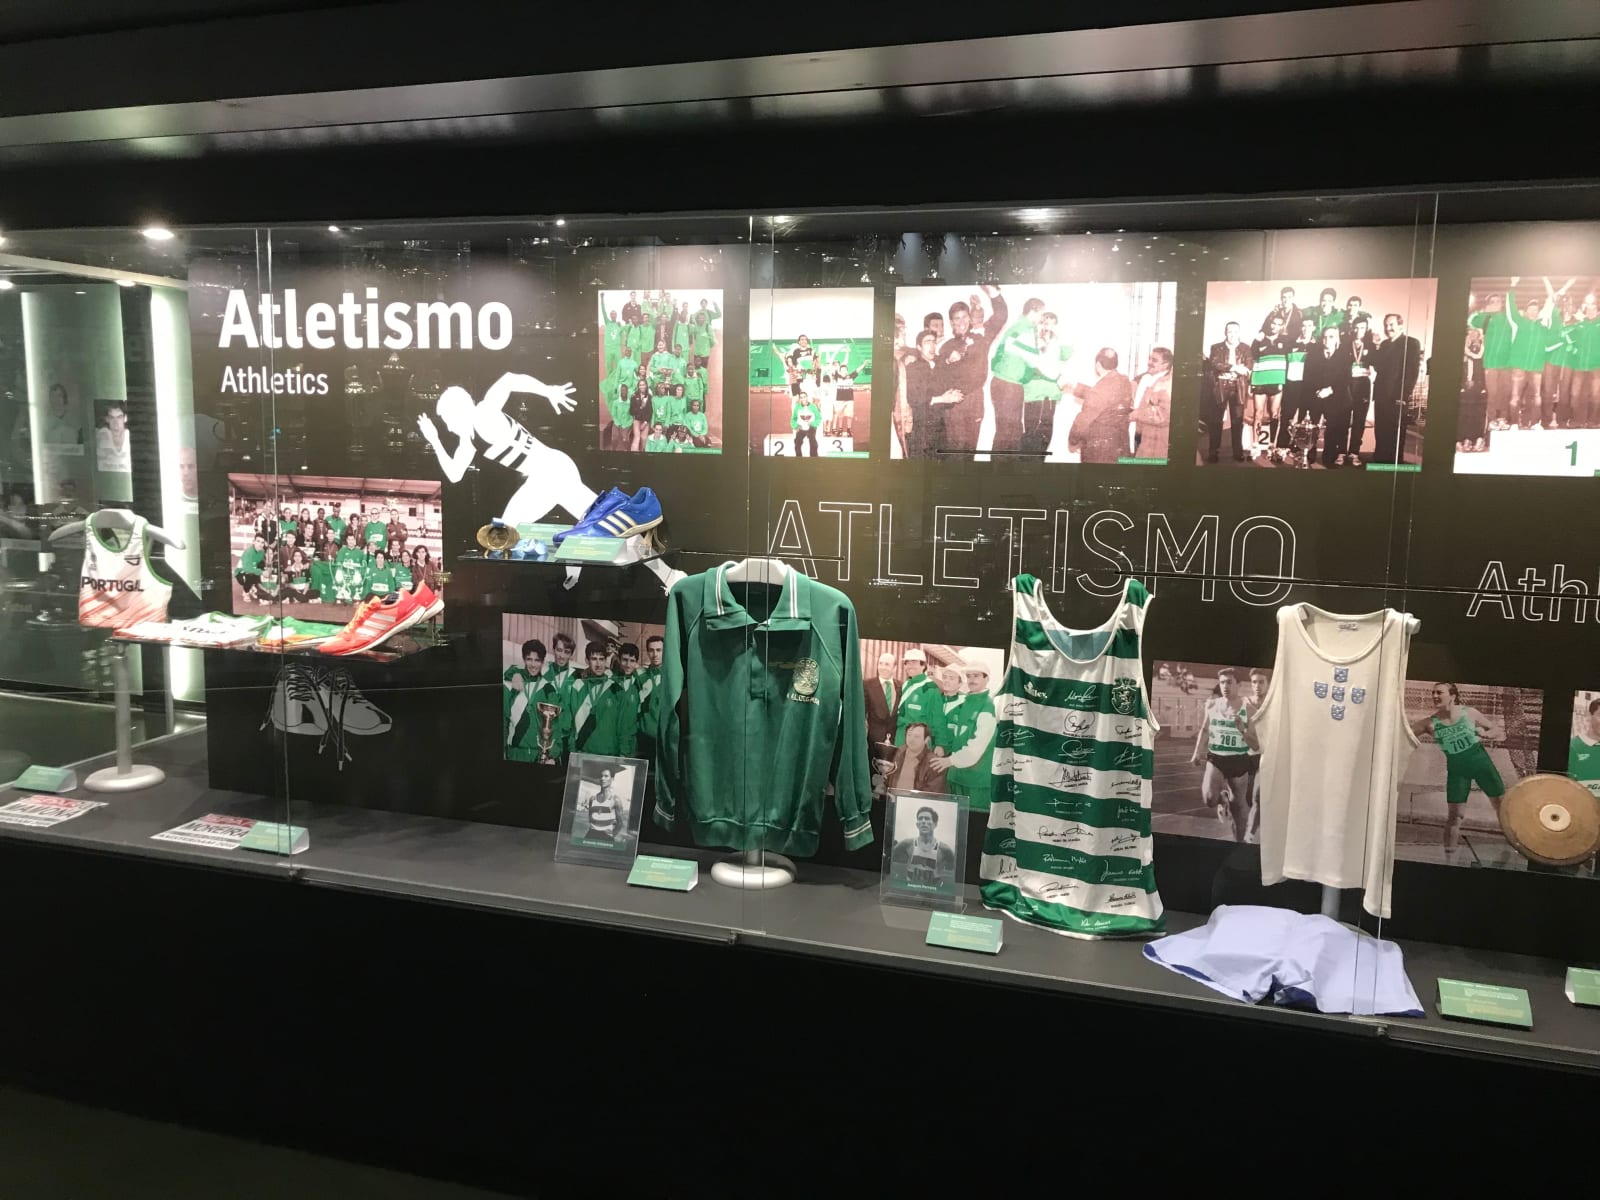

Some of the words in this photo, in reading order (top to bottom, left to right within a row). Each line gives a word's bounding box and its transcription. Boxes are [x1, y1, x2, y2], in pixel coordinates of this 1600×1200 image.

[218, 287, 513, 351] Atletismo
[220, 365, 329, 395] Athletics
[774, 440, 785, 456] 2
[832, 439, 844, 452] 3
[1258, 430, 1269, 445] 2
[1565, 440, 1578, 466] 1
[768, 499, 1296, 607] ATLETISMO
[81, 576, 144, 593] PORTUGAL
[1466, 560, 1600, 624] Ath
[1449, 736, 1471, 752] 701
